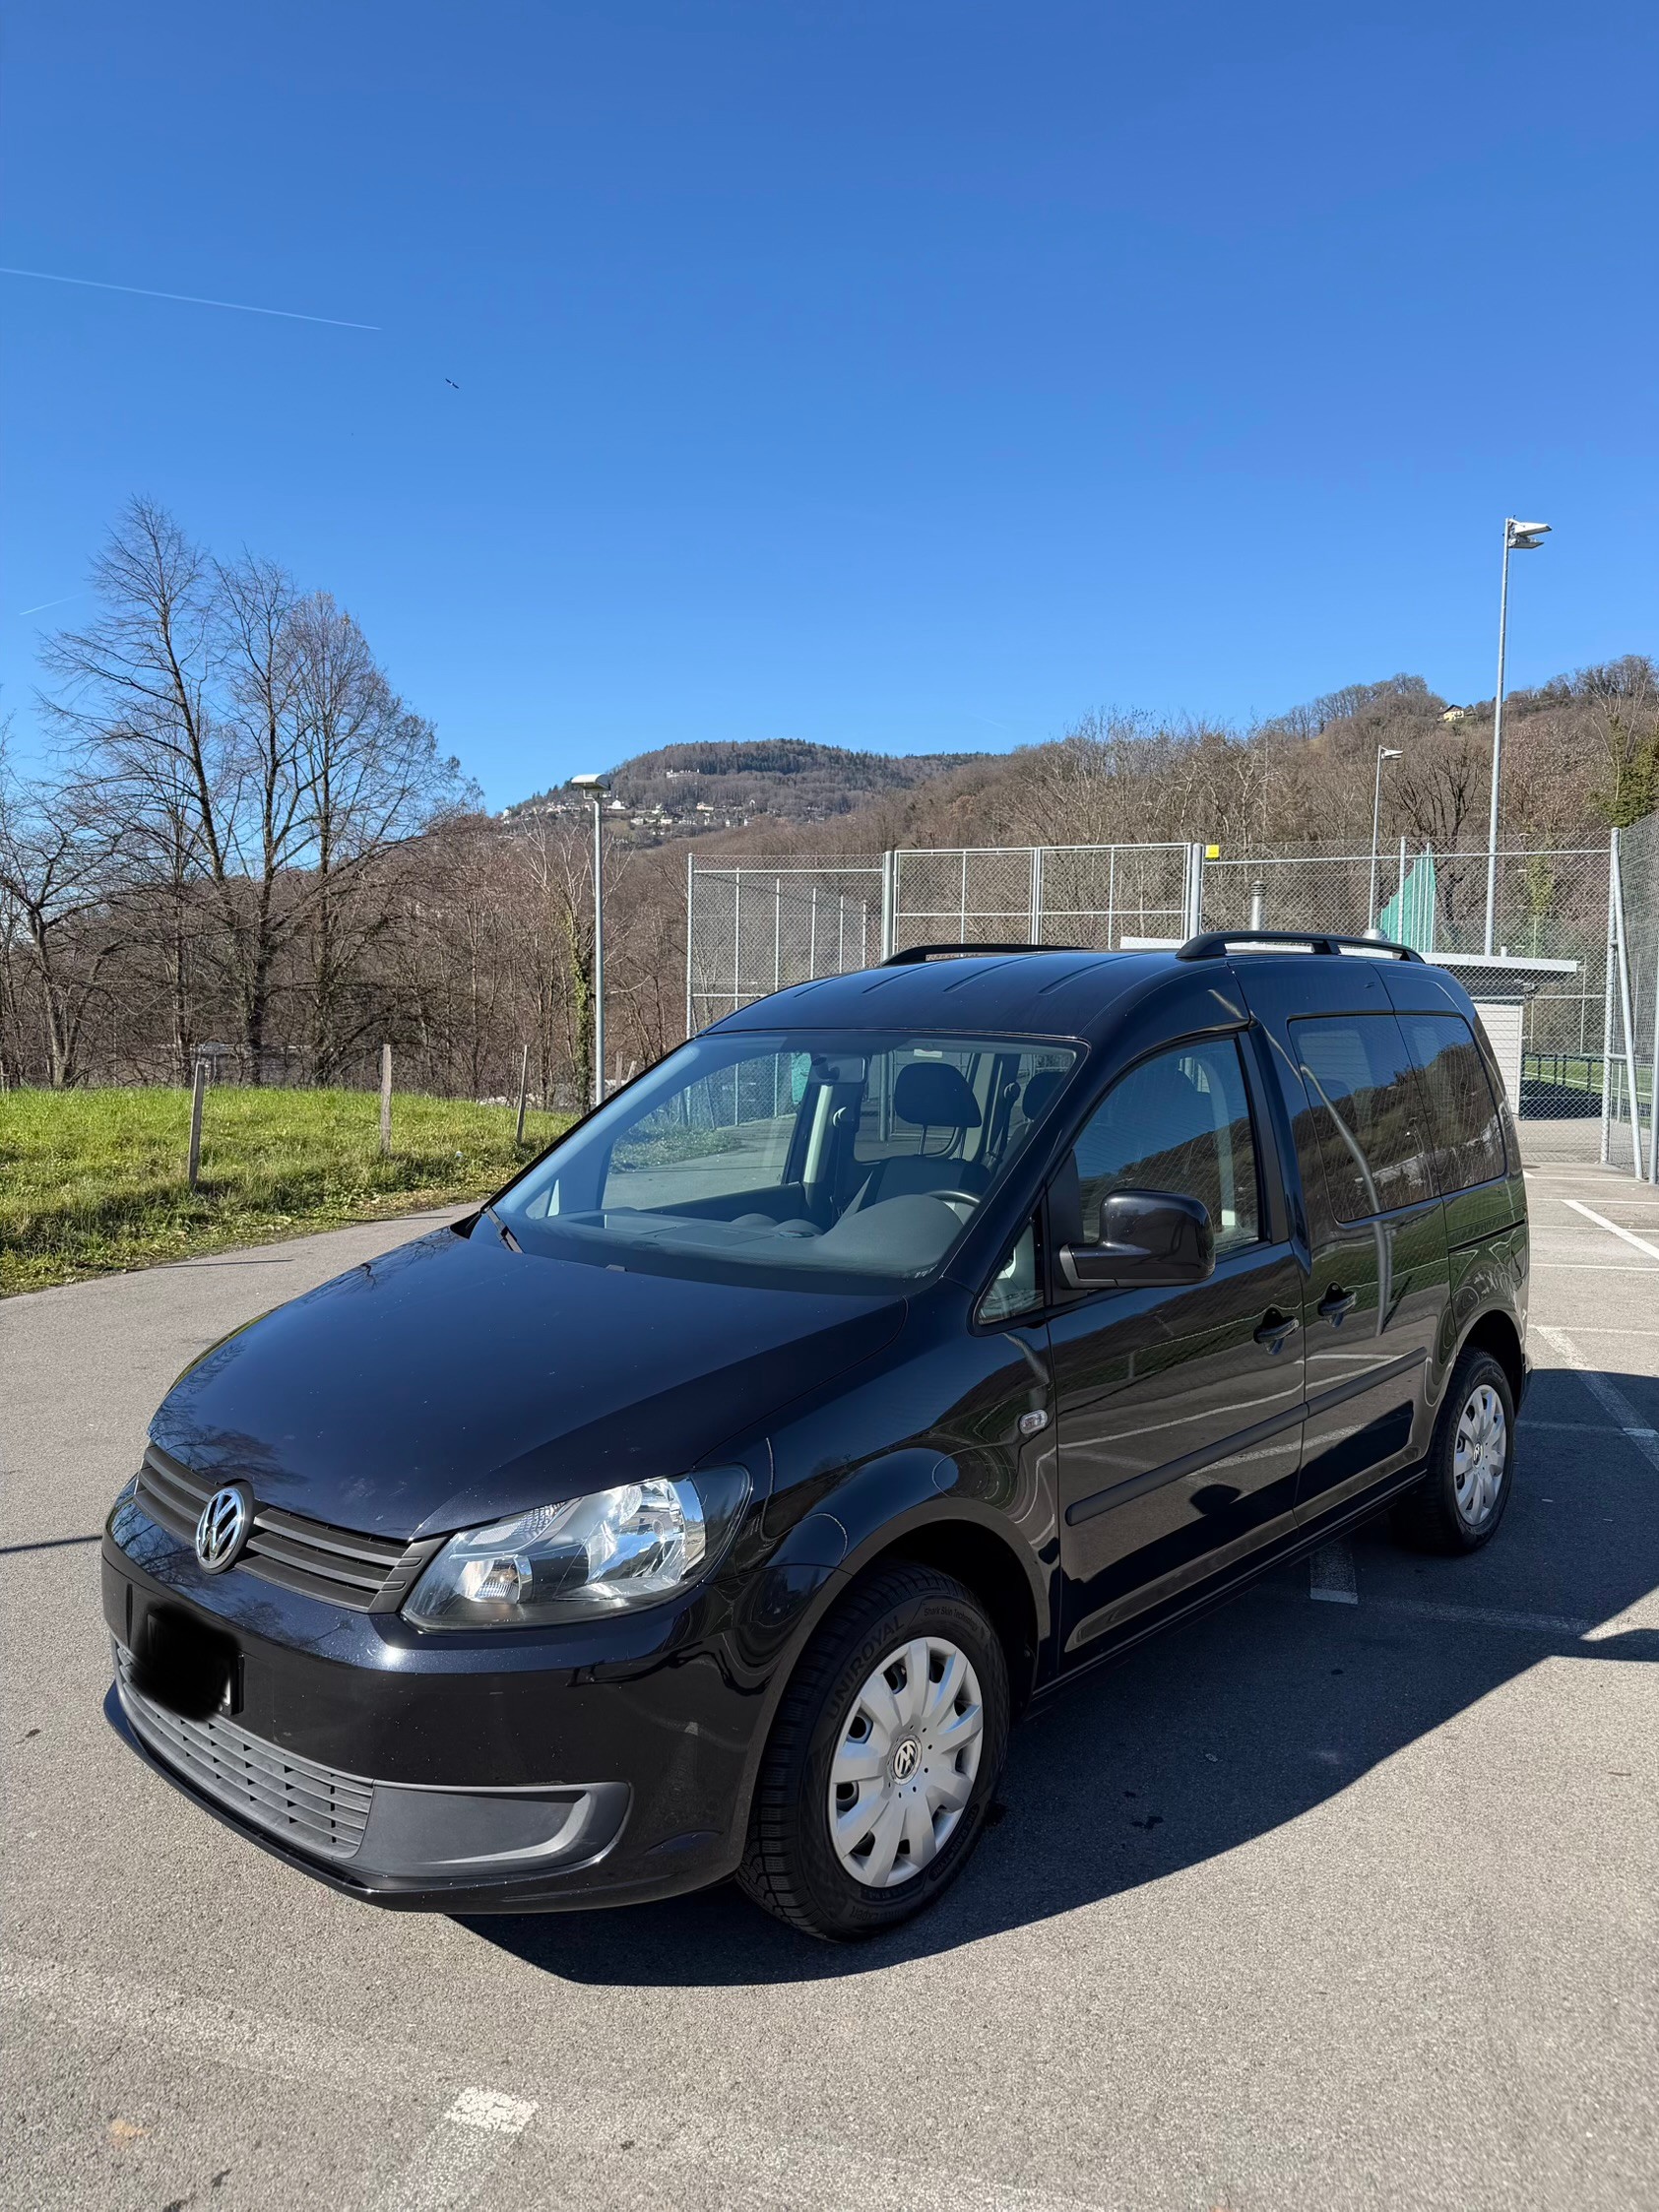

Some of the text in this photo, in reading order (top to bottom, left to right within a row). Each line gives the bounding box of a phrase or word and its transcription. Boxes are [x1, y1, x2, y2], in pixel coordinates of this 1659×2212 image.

[924, 1606, 940, 1616] Shark
[940, 1606, 953, 1615] Skin
[825, 1614, 906, 1721] UNIROYAL
